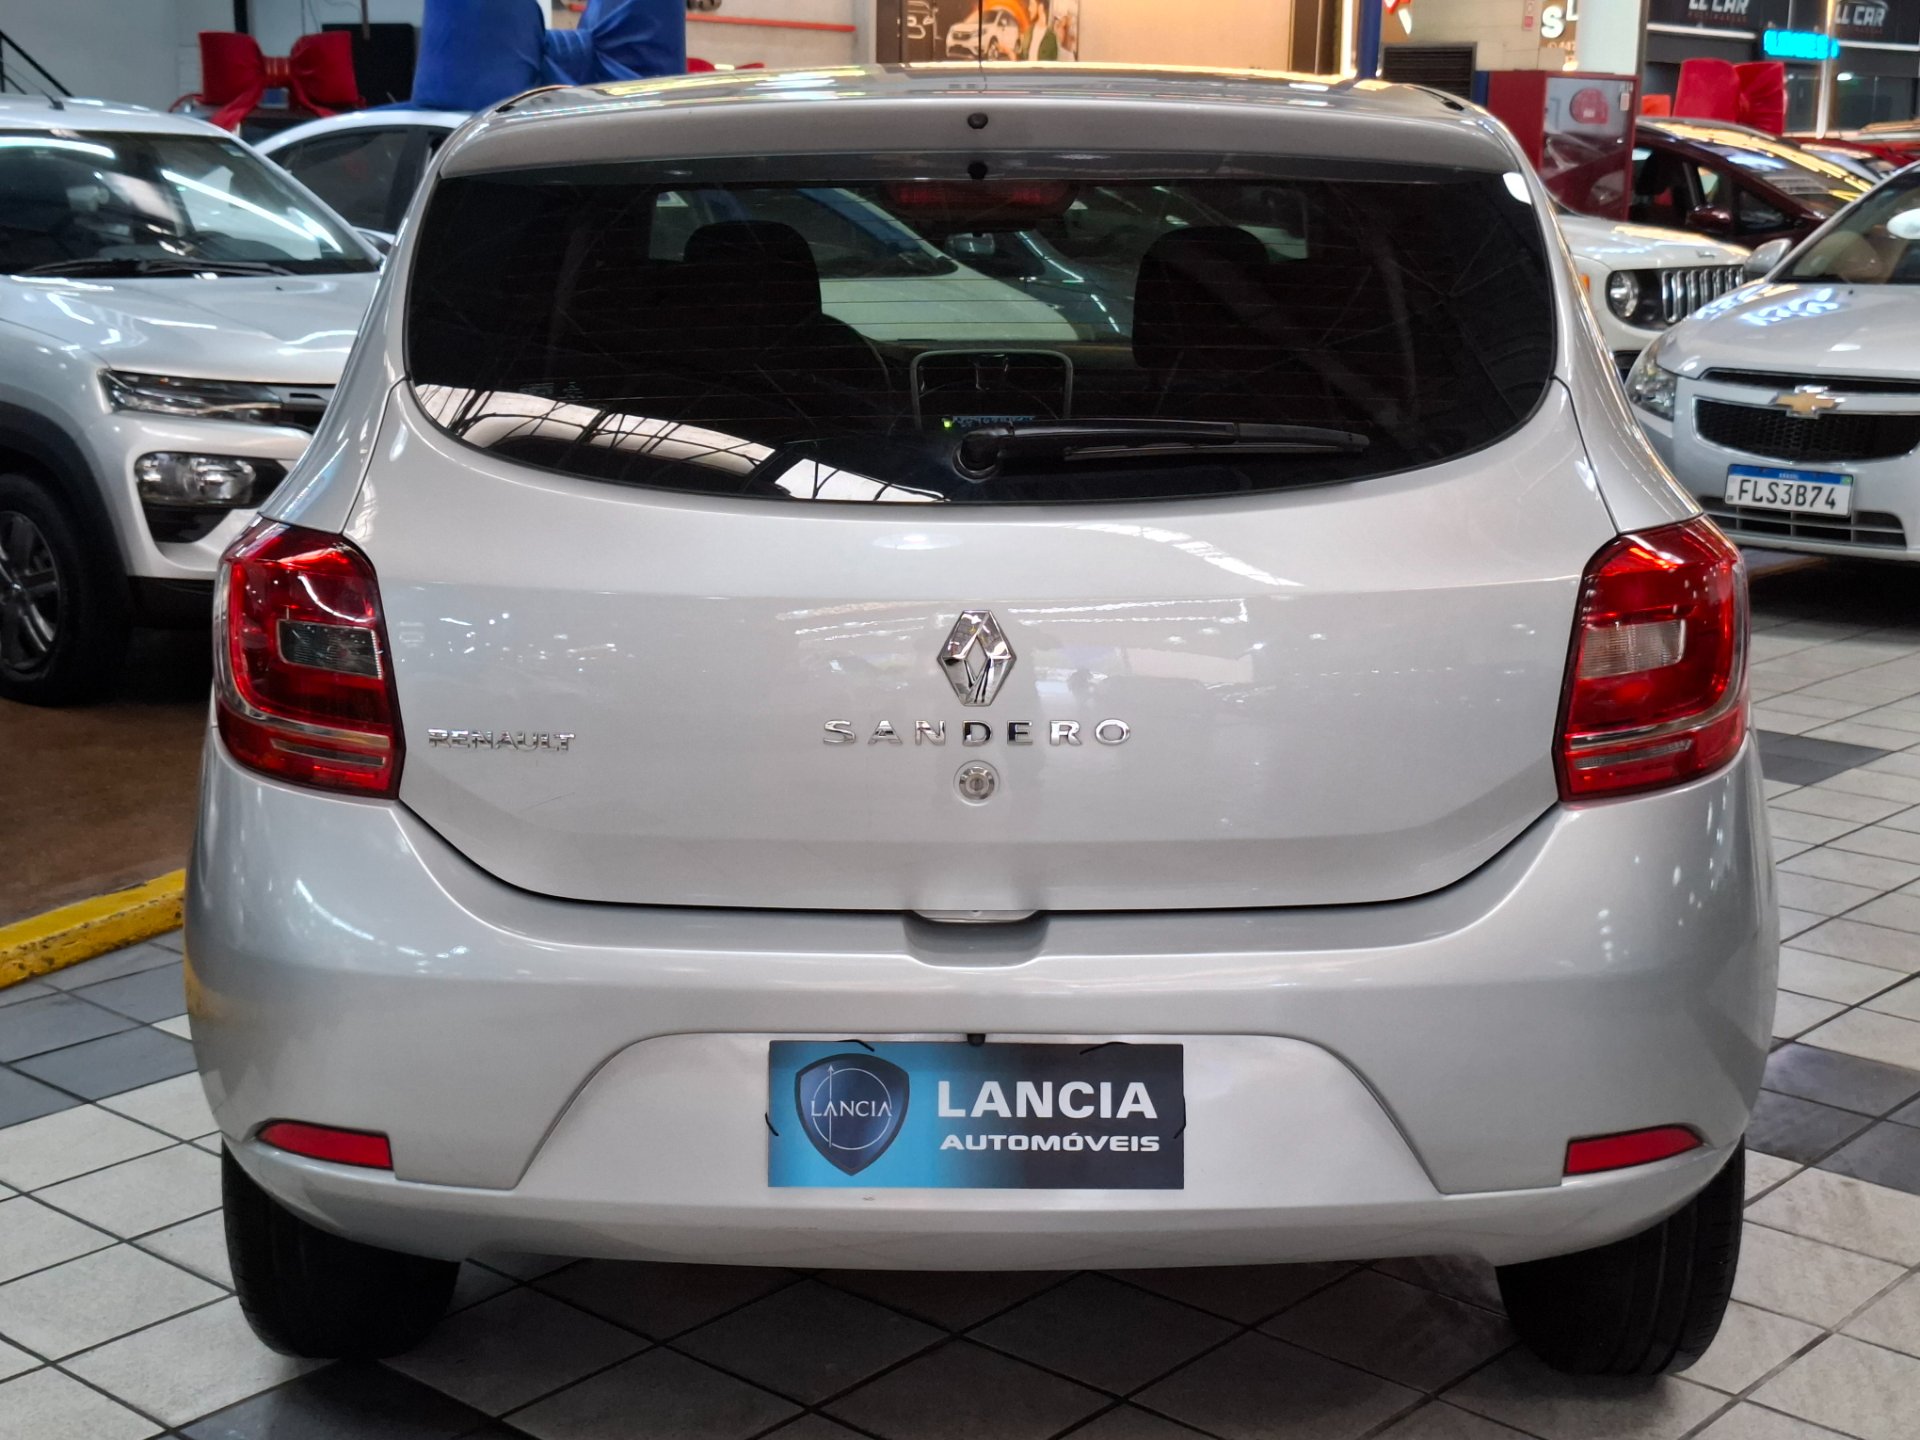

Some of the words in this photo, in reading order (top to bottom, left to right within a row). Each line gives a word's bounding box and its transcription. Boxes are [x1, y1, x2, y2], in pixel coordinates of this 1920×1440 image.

[1711, 0, 1750, 15] CAR
[1853, 5, 1886, 27] CAR
[1738, 479, 1836, 510] FLS3B74
[427, 728, 576, 752] RENAULT
[823, 719, 1132, 747] SANDERO
[810, 1099, 893, 1118] LANCIA
[937, 1080, 1159, 1120] LANCIA
[939, 1132, 1161, 1153] AUTOMÓVEIS
